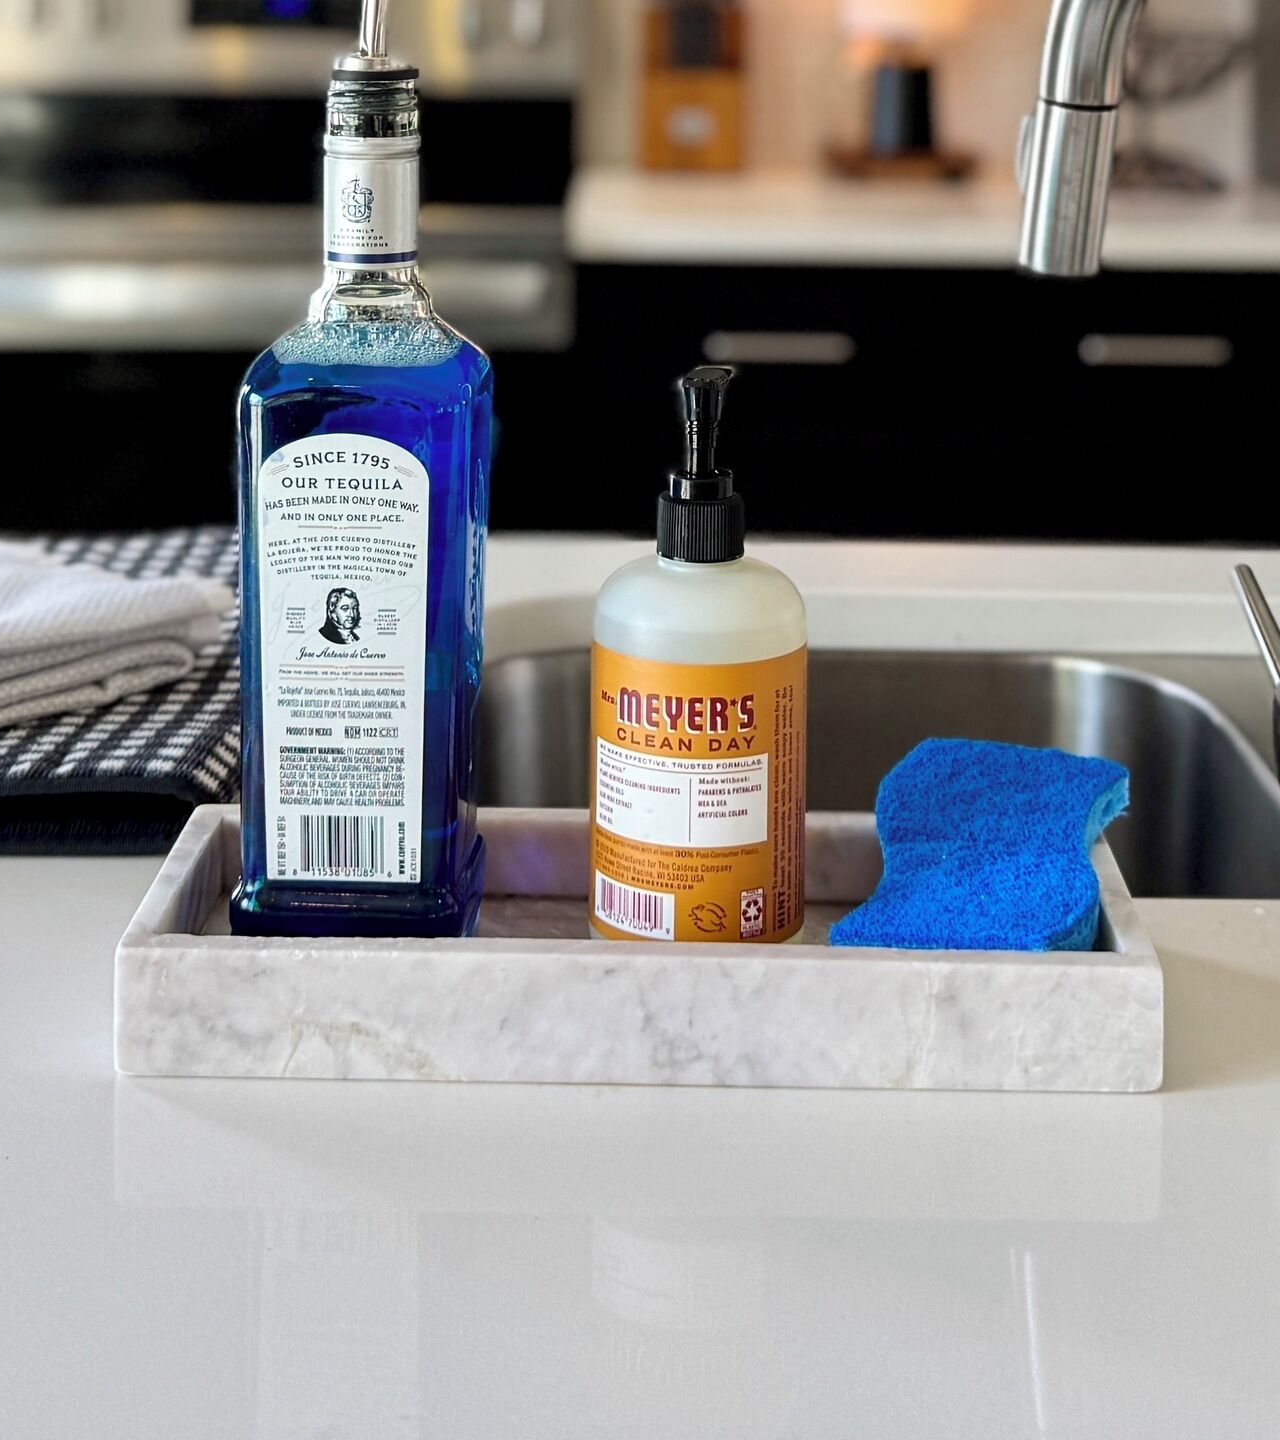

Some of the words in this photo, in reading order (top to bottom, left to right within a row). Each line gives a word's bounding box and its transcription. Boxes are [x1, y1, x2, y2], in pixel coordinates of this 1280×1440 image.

[293, 451, 346, 468] SINCE
[352, 452, 391, 470] 1795
[281, 477, 319, 489] OUR
[324, 478, 403, 491] TEQUILA
[265, 499, 284, 511] HAS
[286, 496, 310, 508] BEEN
[311, 495, 337, 505] MADE
[339, 495, 350, 505] IN
[351, 495, 376, 506] ONLY
[377, 498, 398, 509] ONE
[280, 512, 302, 521] AND
[304, 513, 315, 521] IN
[317, 513, 344, 522] ONLY
[346, 514, 368, 522] ONE
[370, 514, 405, 523] PLACE.
[341, 535, 371, 544] CUERVO
[373, 538, 416, 550] DISTILLERY
[374, 547, 401, 557] HONOR
[403, 551, 418, 560] THE
[270, 557, 297, 567] LEGACY
[362, 555, 397, 566] FOUNDED
[398, 560, 414, 569] OUR
[277, 564, 316, 575] DISTILLERY
[343, 564, 373, 572] MAGICAL
[375, 566, 396, 575] TOWN
[349, 649, 359, 659] de
[601, 689, 618, 706] Mrs.
[362, 727, 378, 738] 1122
[616, 727, 693, 752] CLEAN
[708, 735, 756, 753] DAY
[280, 745, 317, 755] GOVERNMENT
[624, 753, 669, 768] EFFECTIVE,
[672, 761, 714, 770] TRUSTED
[698, 777, 719, 785] Made
[720, 775, 750, 784] without:
[698, 788, 726, 796] PARABENS
[698, 810, 727, 819] ARTIFICIAL
[728, 808, 749, 818] COLORS
[398, 821, 406, 875] www.cuervo.com
[311, 867, 341, 877] 11538
[344, 868, 376, 878] 01085
[387, 870, 394, 878] 6
[658, 860, 670, 871] The
[700, 863, 733, 875] Company
[690, 873, 705, 883] USA
[777, 891, 786, 929] HINT
